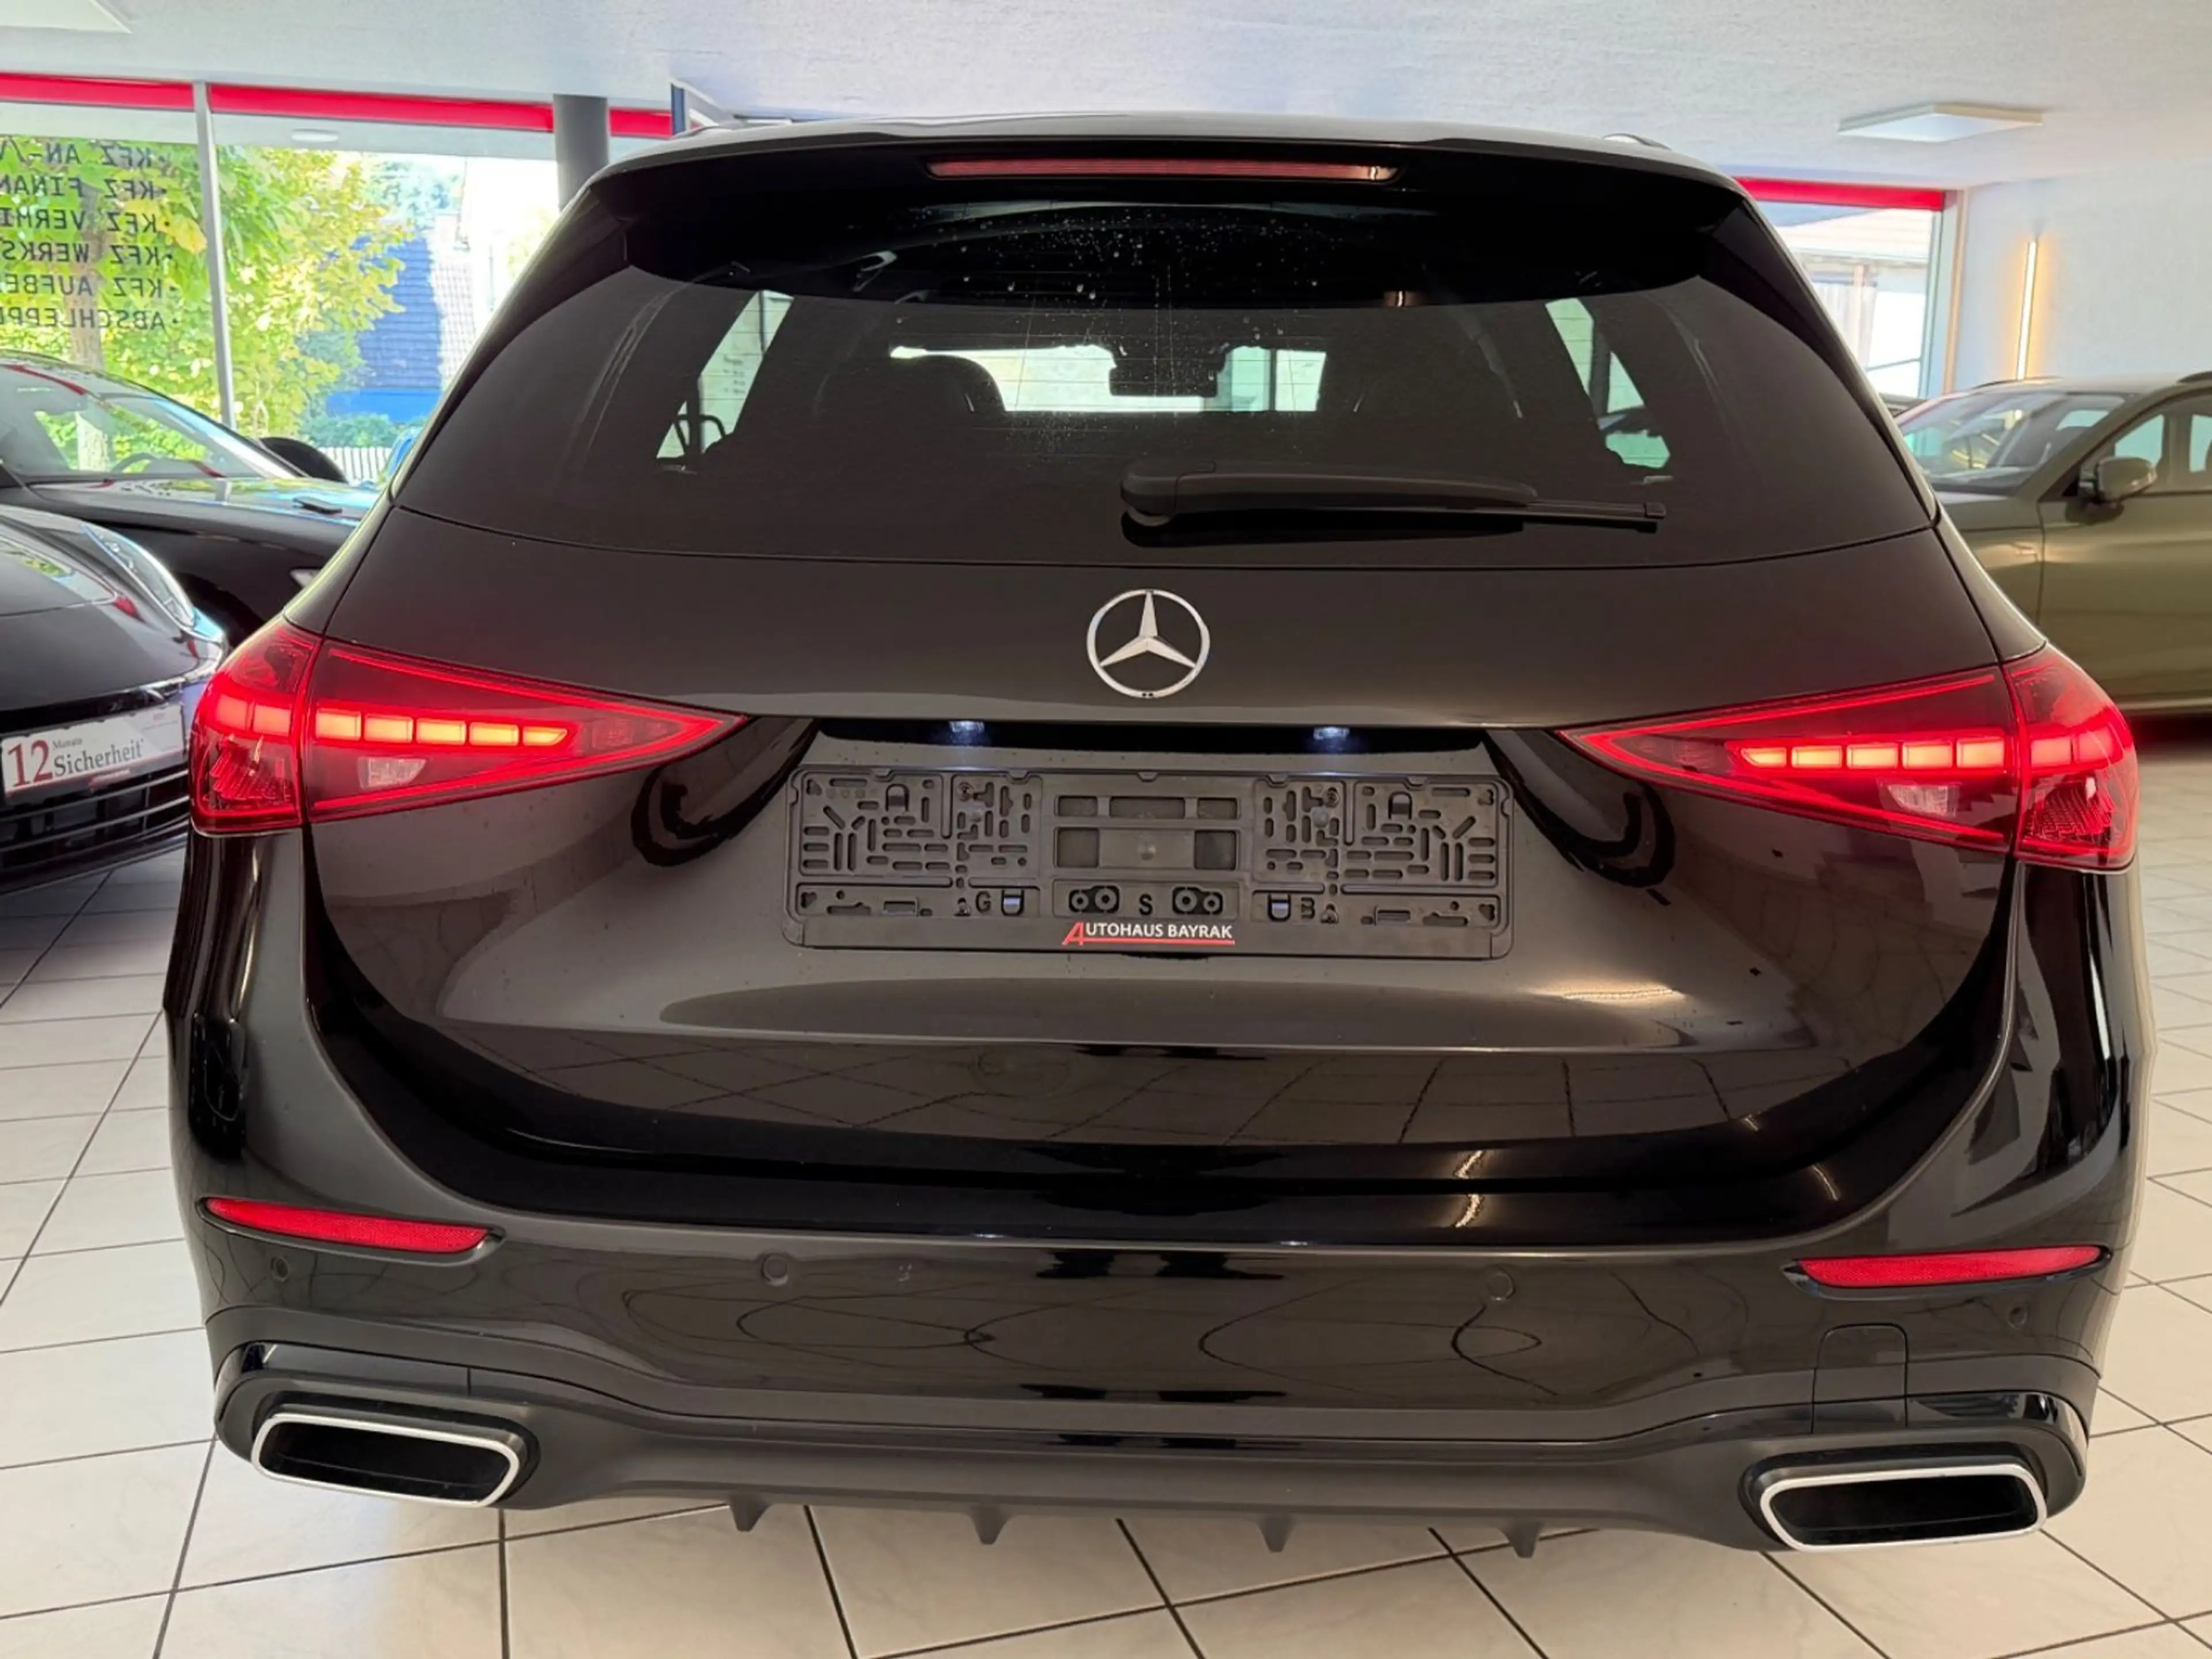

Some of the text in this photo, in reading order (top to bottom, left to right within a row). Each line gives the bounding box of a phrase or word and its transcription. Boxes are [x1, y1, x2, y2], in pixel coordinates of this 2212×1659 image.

[8, 740, 53, 787] 12
[1062, 921, 1233, 945] AUTOHAUS BAYRAK
